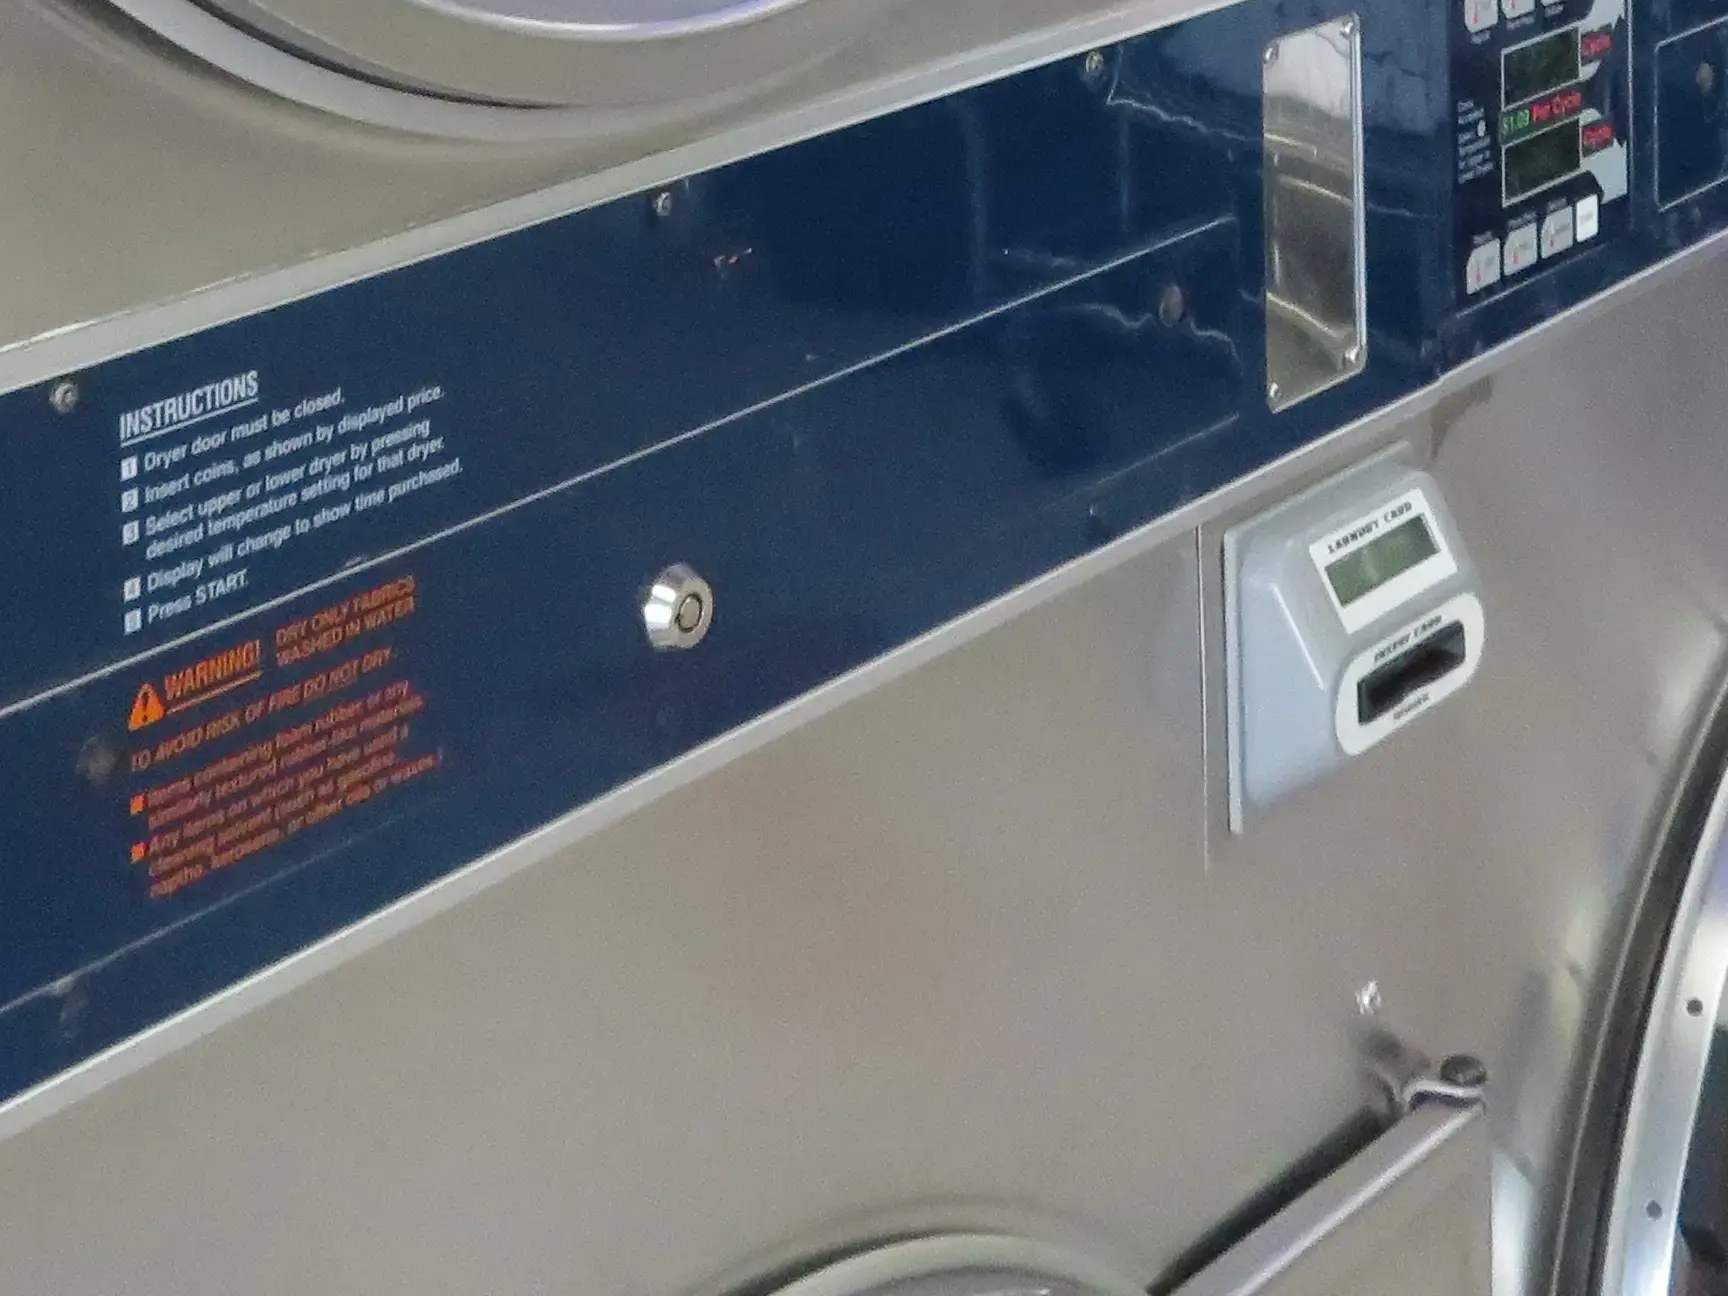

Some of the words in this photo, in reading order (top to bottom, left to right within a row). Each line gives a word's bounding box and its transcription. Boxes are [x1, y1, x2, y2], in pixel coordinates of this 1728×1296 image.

[120, 369, 259, 439] INSTRUCTIONS
[143, 444, 187, 472] Dryer
[191, 430, 228, 455] door
[231, 413, 268, 441] must
[270, 408, 291, 427] be
[293, 387, 345, 419] closed.
[144, 473, 189, 503] Insert
[242, 449, 261, 468] as
[264, 432, 313, 460] shown
[316, 423, 334, 444] by
[337, 396, 404, 434] displayed
[407, 385, 445, 409] price.
[144, 505, 194, 535] Select
[197, 489, 242, 515] upper
[246, 481, 261, 499] or
[265, 462, 306, 491] lower
[308, 449, 348, 476] dryer
[350, 442, 369, 461] by
[371, 418, 430, 453] pressing
[146, 524, 203, 559] desired
[207, 492, 298, 535] temperature
[300, 471, 351, 501] setting
[353, 462, 374, 482] for
[377, 451, 404, 473] that
[147, 558, 203, 593] Display
[208, 543, 233, 568] will
[236, 524, 291, 557] change
[295, 518, 310, 535] to
[312, 500, 351, 526] show
[354, 488, 385, 509] time
[387, 458, 464, 501] purchased.
[1328, 521, 1380, 555] LAUNDRY
[1383, 502, 1413, 523] CARD
[147, 596, 192, 624] Press
[164, 639, 260, 701] WARNING!
